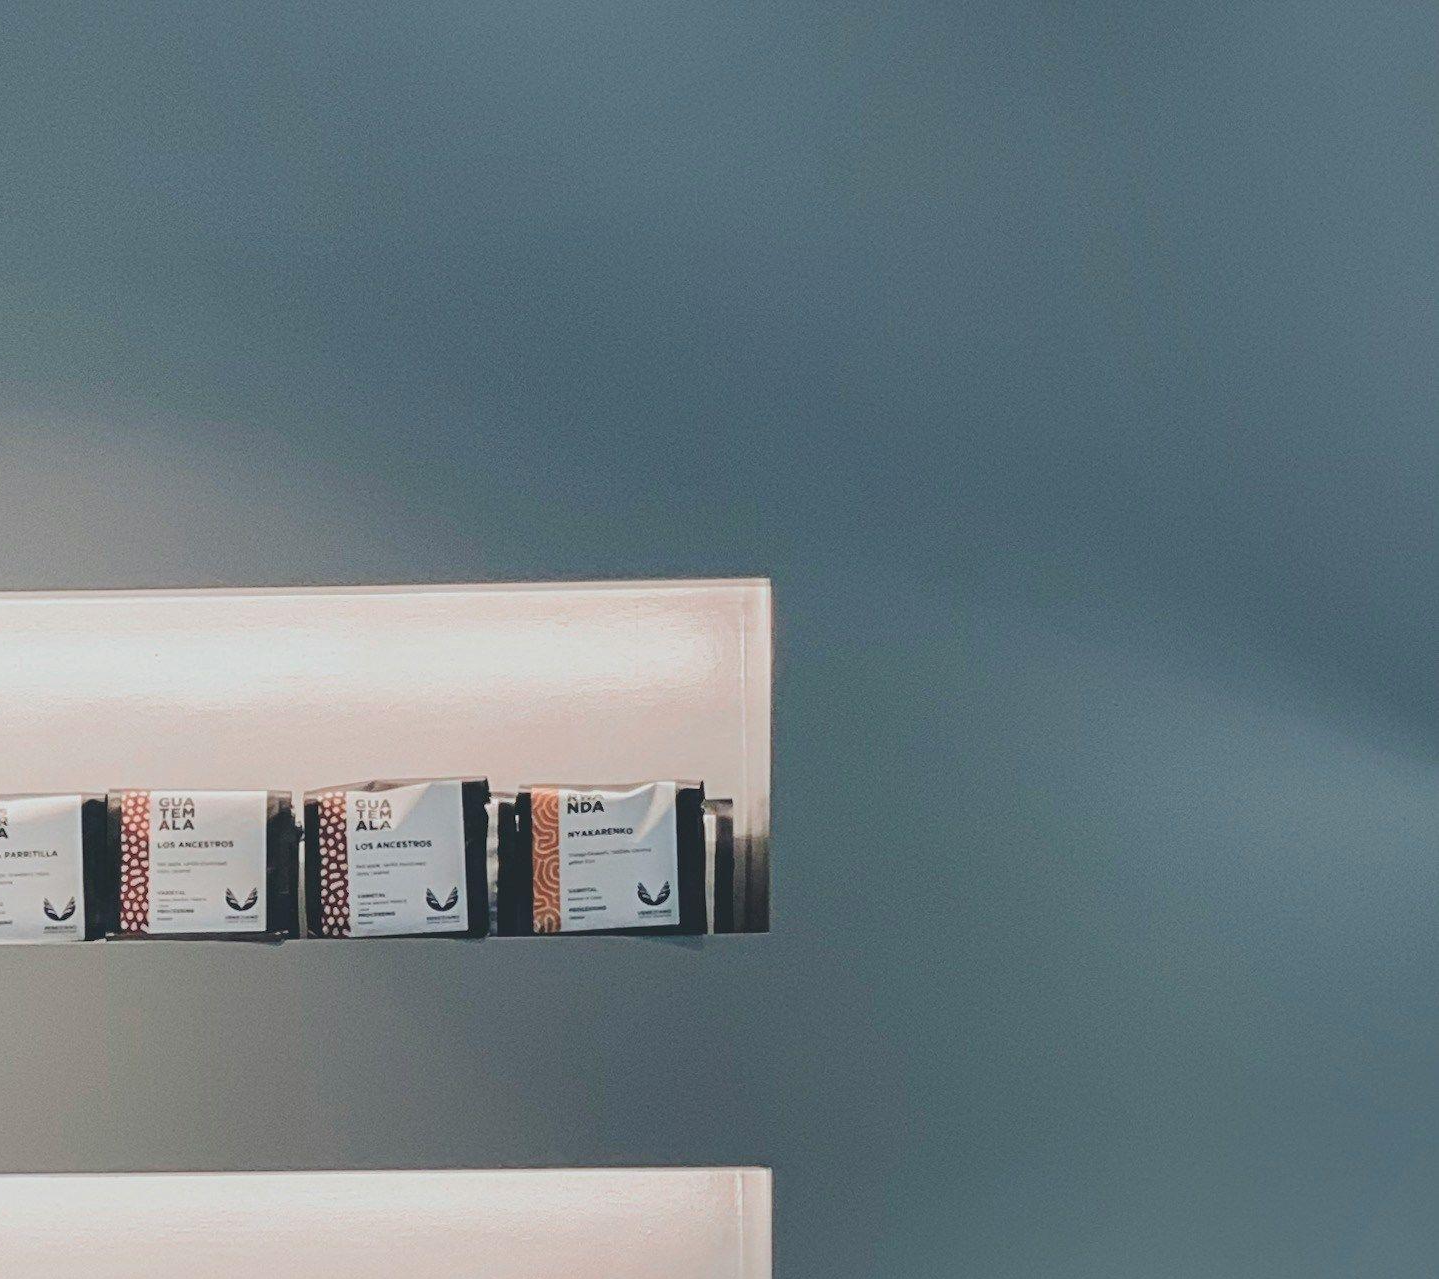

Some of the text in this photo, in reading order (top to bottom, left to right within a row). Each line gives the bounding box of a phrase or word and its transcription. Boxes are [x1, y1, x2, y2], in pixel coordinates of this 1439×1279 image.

[159, 797, 194, 808] GUA
[356, 799, 391, 810] GUA
[567, 800, 604, 814] NDA
[159, 808, 195, 818] TEM
[356, 809, 392, 819] TEM
[159, 819, 194, 831] ALA
[356, 820, 392, 831] ALA
[157, 840, 234, 849] LOS ANCESTROS
[355, 840, 432, 851] LOS ANCESTROS
